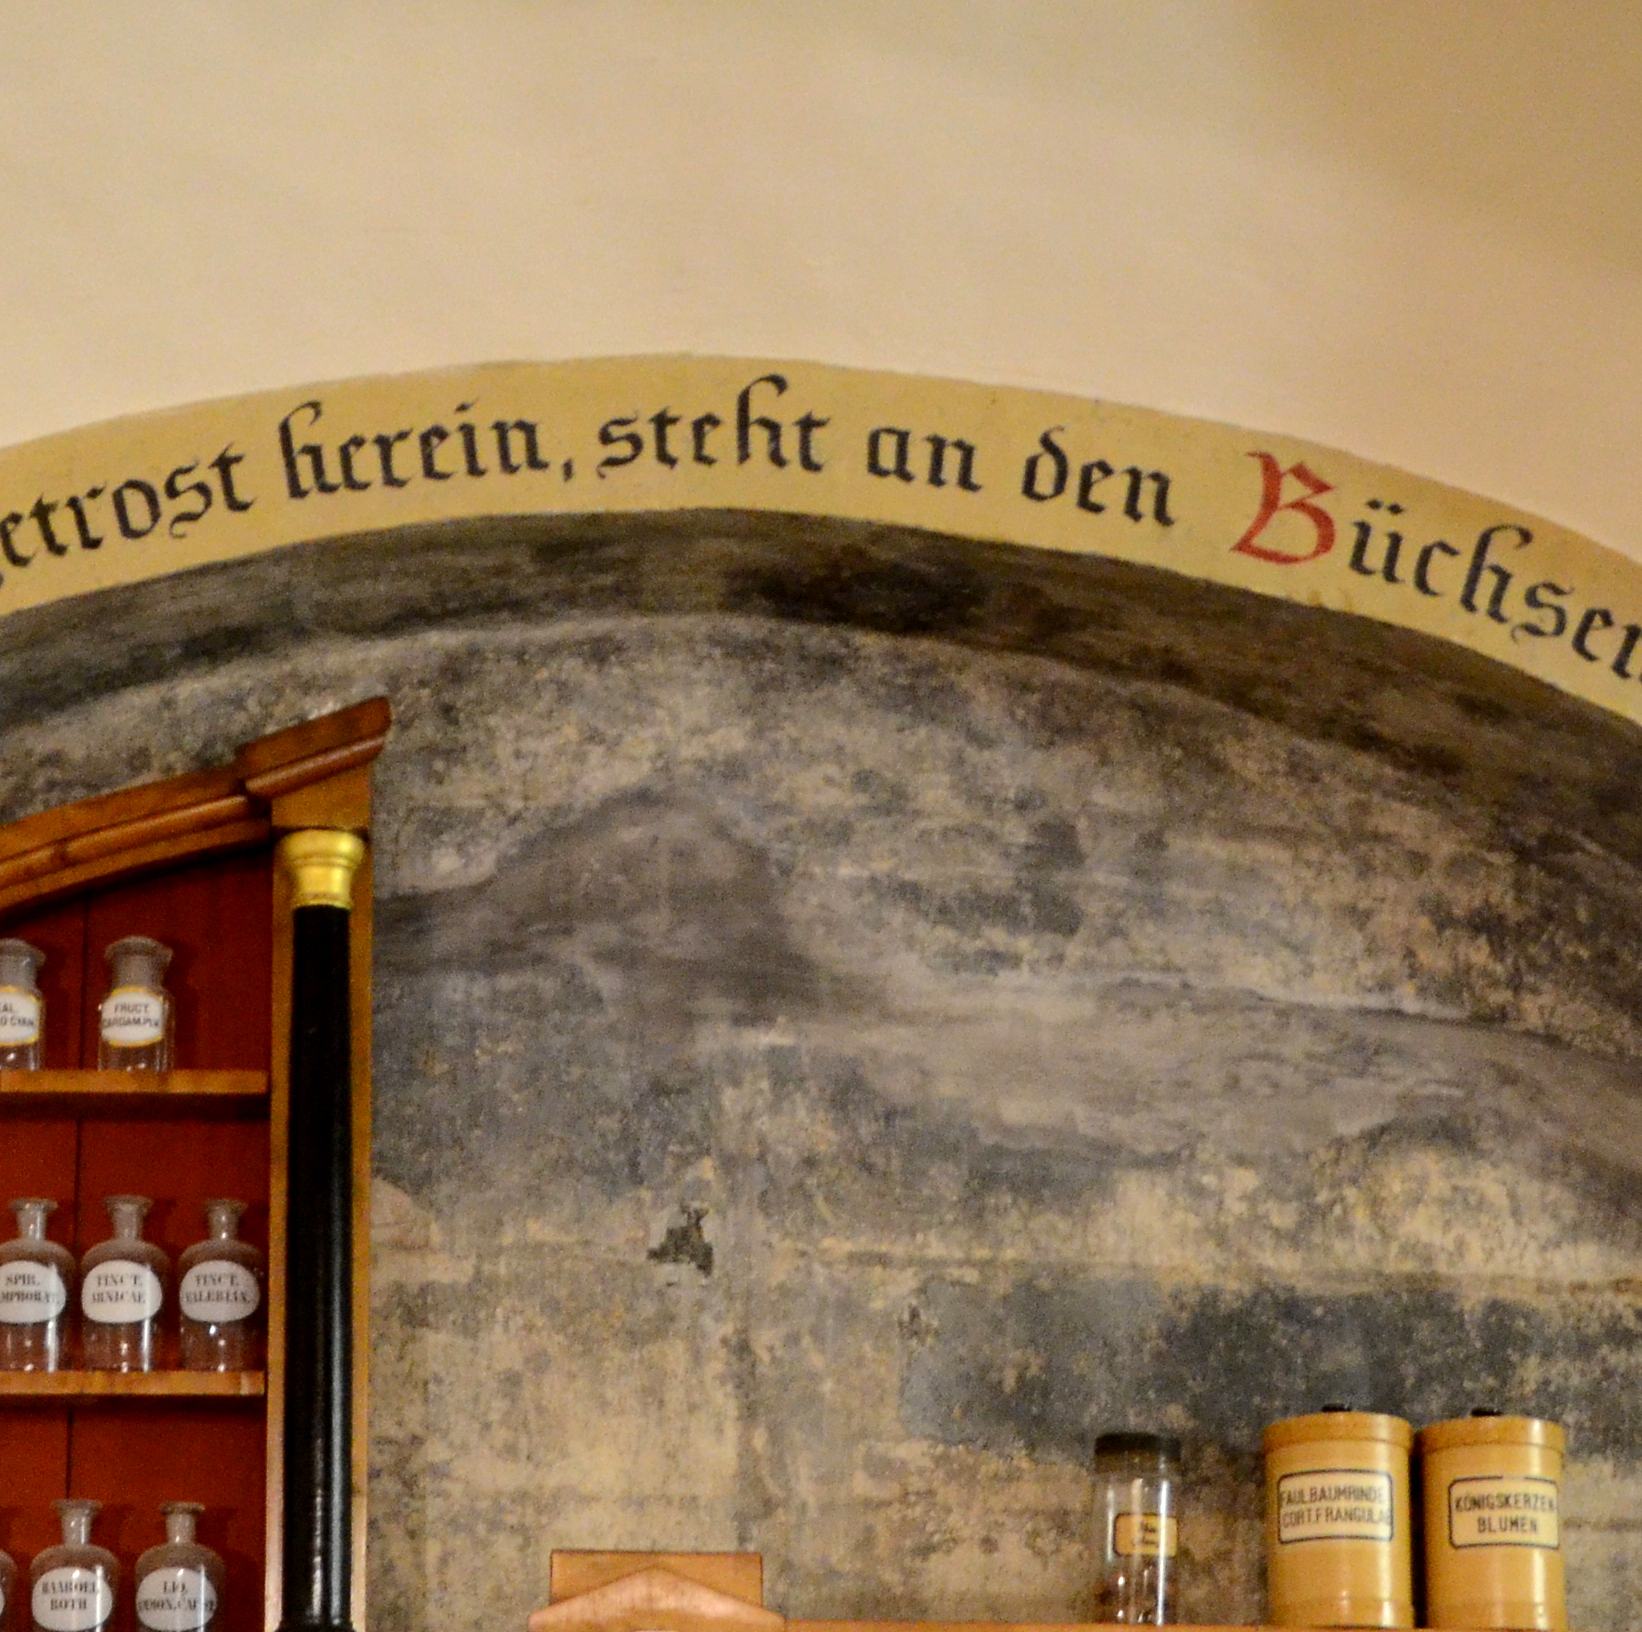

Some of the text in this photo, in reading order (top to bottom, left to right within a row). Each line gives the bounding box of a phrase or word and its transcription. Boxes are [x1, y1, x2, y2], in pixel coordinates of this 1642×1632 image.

[279, 400, 573, 503] herein,
[595, 373, 834, 476] steht
[864, 418, 980, 495] an
[1017, 425, 1177, 527] den
[1476, 1516, 1538, 1534] BLUMEN
